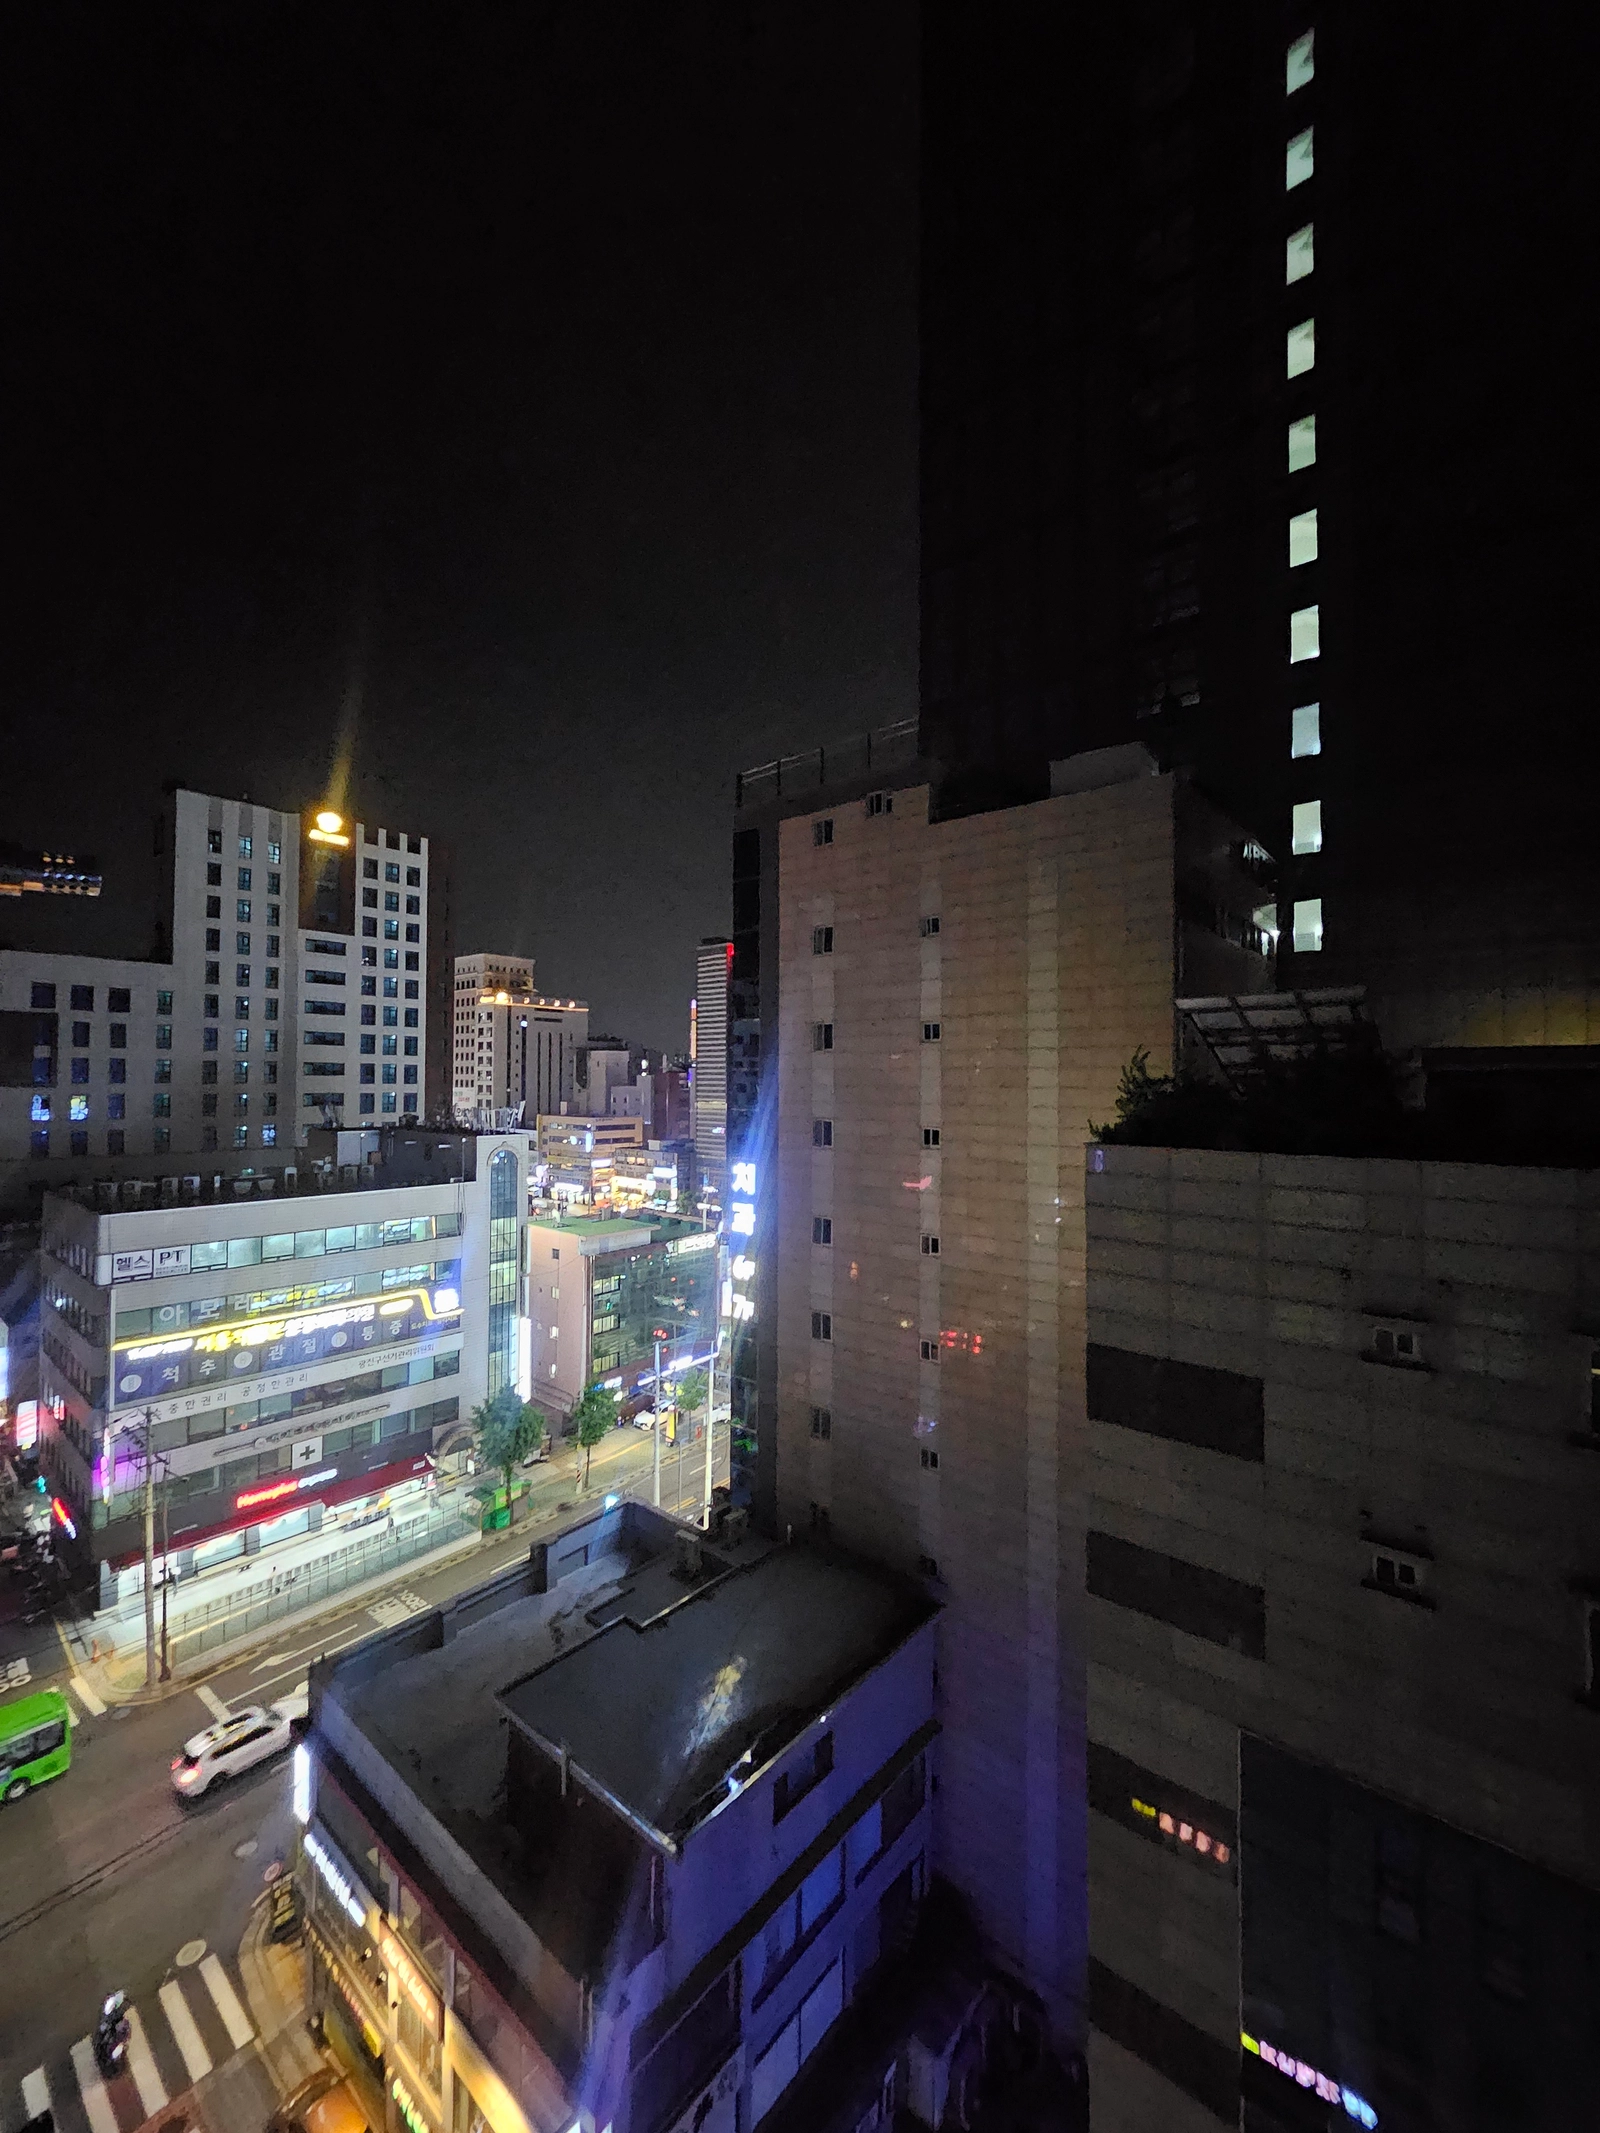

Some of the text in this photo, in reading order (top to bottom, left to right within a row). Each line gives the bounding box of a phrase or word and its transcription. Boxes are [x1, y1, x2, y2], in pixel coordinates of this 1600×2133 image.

[731, 1162, 756, 1235] 치과
[116, 1255, 150, 1272] 헬스
[159, 1249, 186, 1265] PT
[162, 1319, 402, 1383] 척추 관절 통증
